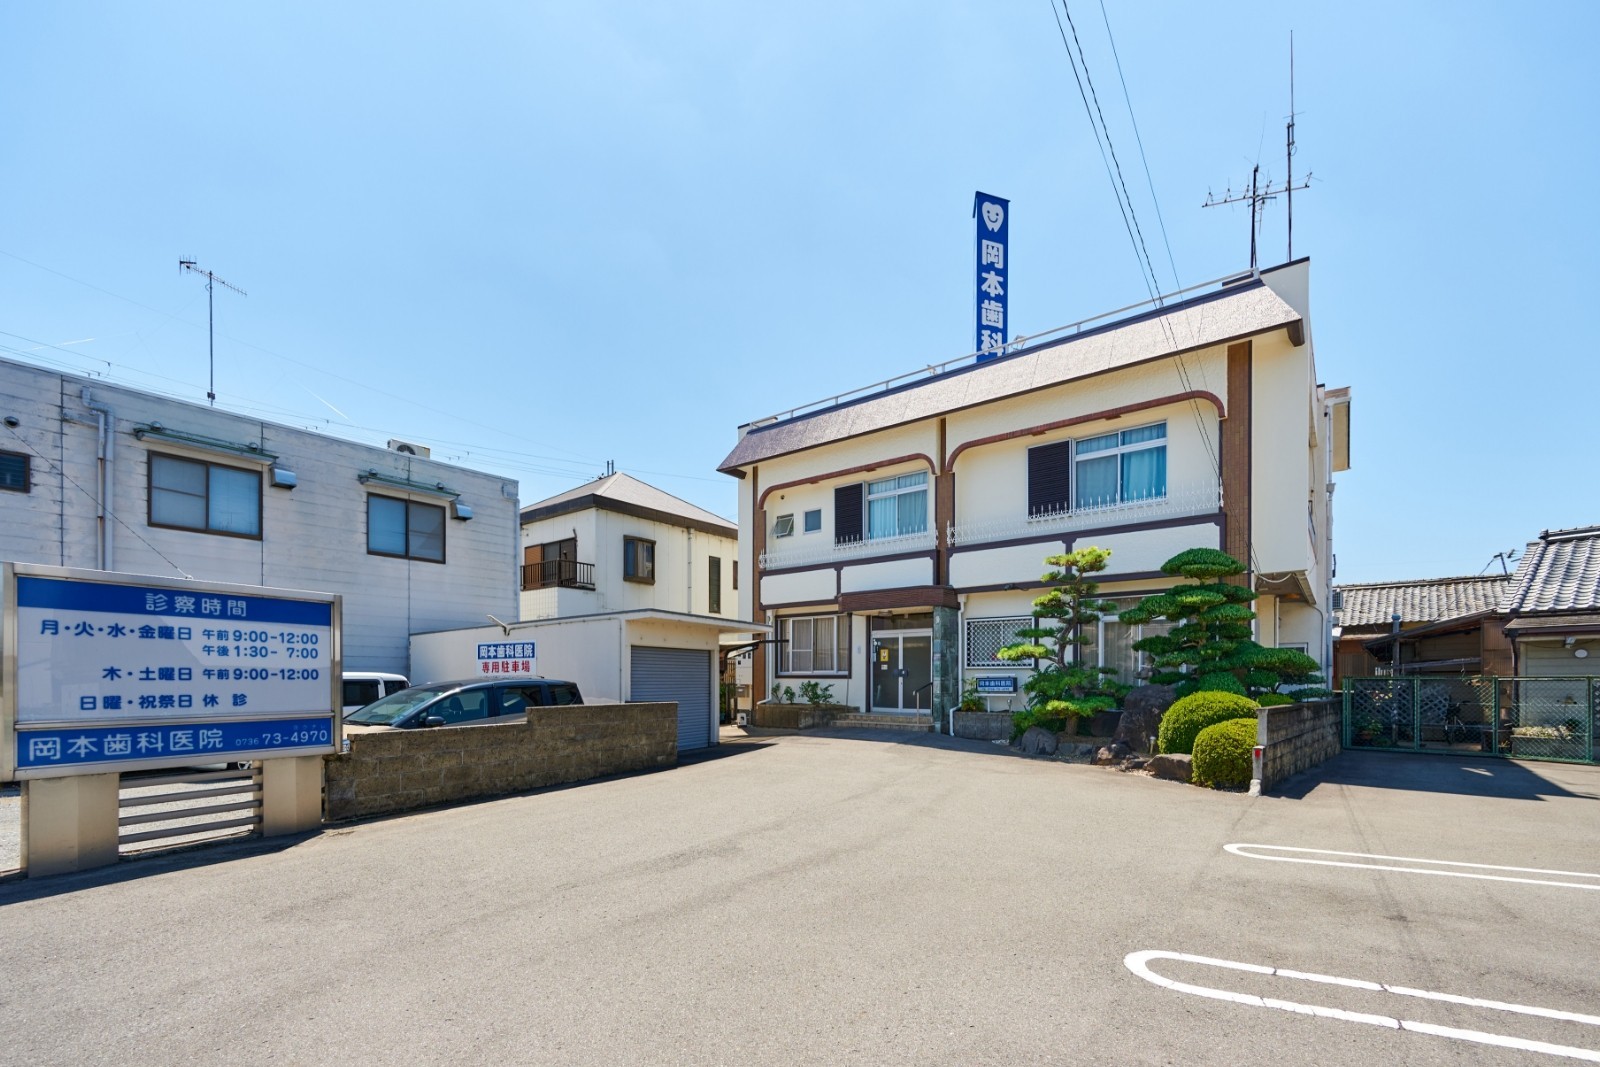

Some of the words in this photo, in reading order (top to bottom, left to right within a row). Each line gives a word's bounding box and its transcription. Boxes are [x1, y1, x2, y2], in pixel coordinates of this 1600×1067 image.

[981, 239, 1005, 357] 岡本歯科
[145, 592, 247, 617] 診察時間
[40, 619, 193, 641] 月・火・水・金曜日
[479, 644, 533, 658] 岡本歯科医院
[102, 666, 193, 681] 木・土曜日
[482, 660, 530, 673] 専用駐車場
[29, 728, 223, 761] 岡本歯科医院
[235, 738, 259, 746] 0736
[262, 730, 328, 745] 73-4970
